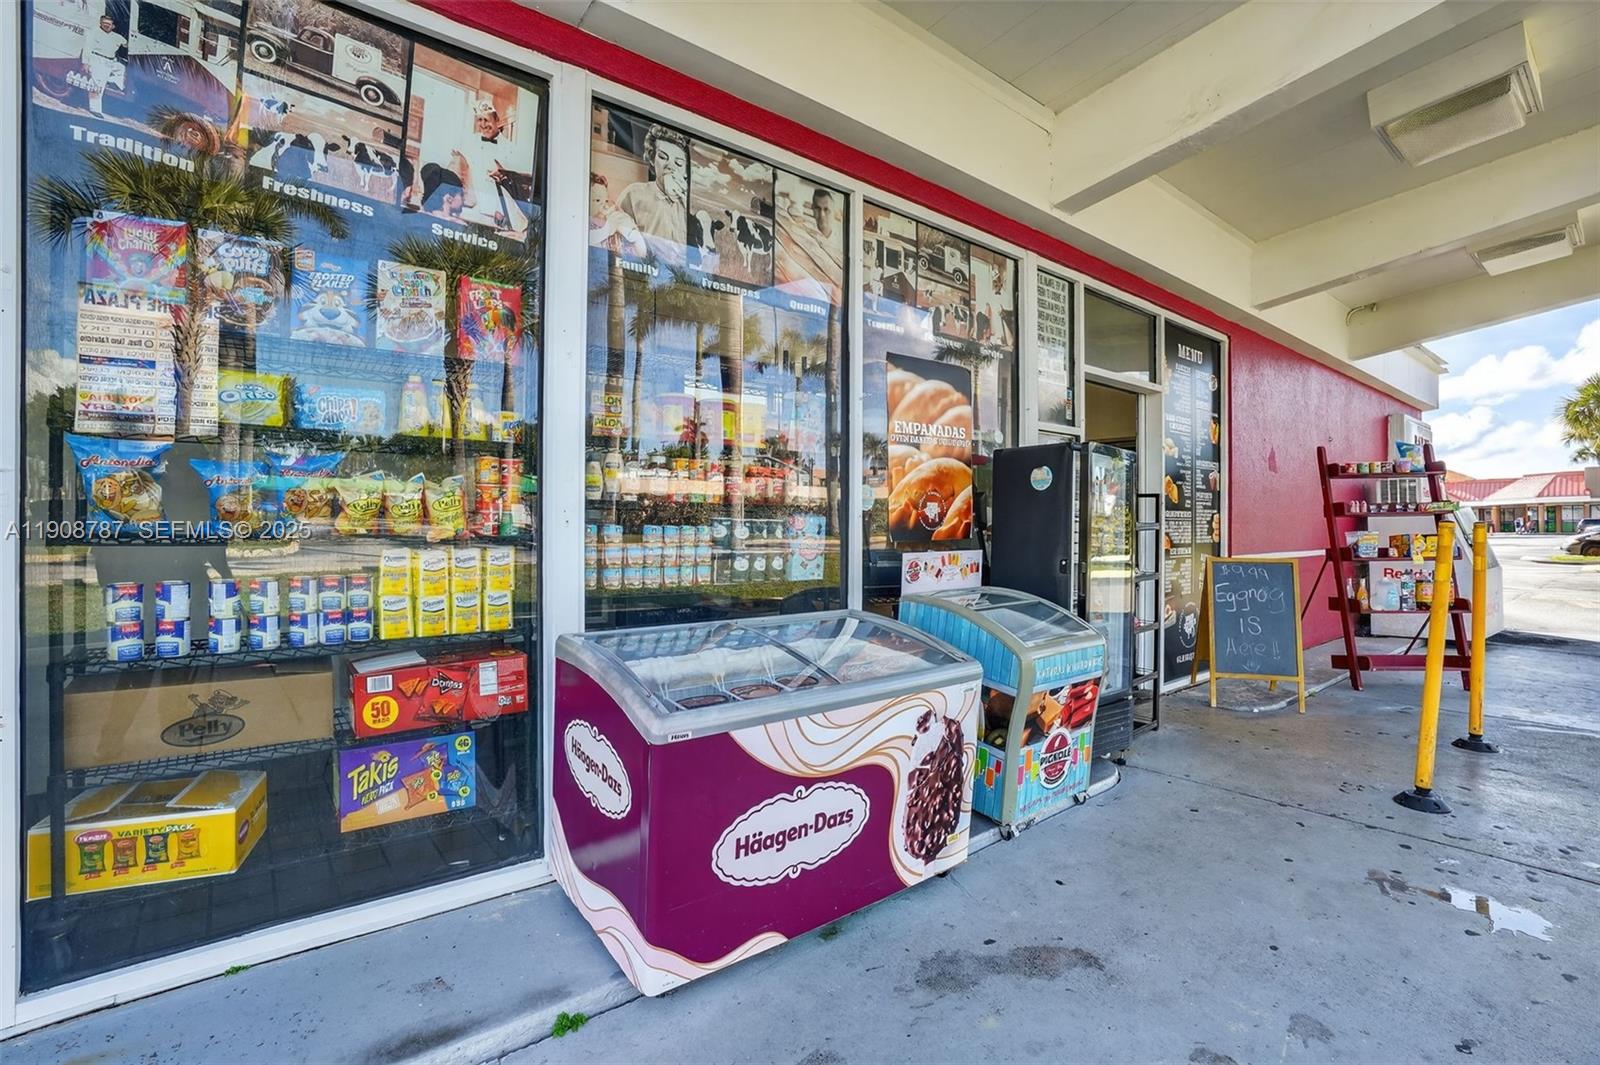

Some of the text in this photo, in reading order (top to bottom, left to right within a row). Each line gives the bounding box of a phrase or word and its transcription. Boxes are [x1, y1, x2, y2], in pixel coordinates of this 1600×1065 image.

[69, 124, 195, 173] Tradition
[261, 176, 374, 217] Freshness
[431, 223, 498, 251] Service
[616, 257, 659, 276] Family
[701, 278, 761, 300] Freshness
[789, 300, 828, 317] Quality
[1177, 343, 1203, 365] MENU
[219, 388, 276, 404] OREO
[317, 396, 352, 412] Chips
[894, 420, 966, 439] EMPANADAS
[1214, 582, 1286, 615] Eggnog
[1239, 615, 1262, 636] IS
[1225, 637, 1266, 657] Here
[371, 700, 391, 718] 50
[177, 718, 234, 739] Pelly
[571, 735, 622, 797] Häagen-Dazs
[347, 756, 399, 801] Takis
[117, 826, 165, 838] VARIETY
[165, 823, 196, 834] PACK
[734, 808, 854, 860] Häagen-Dazs
